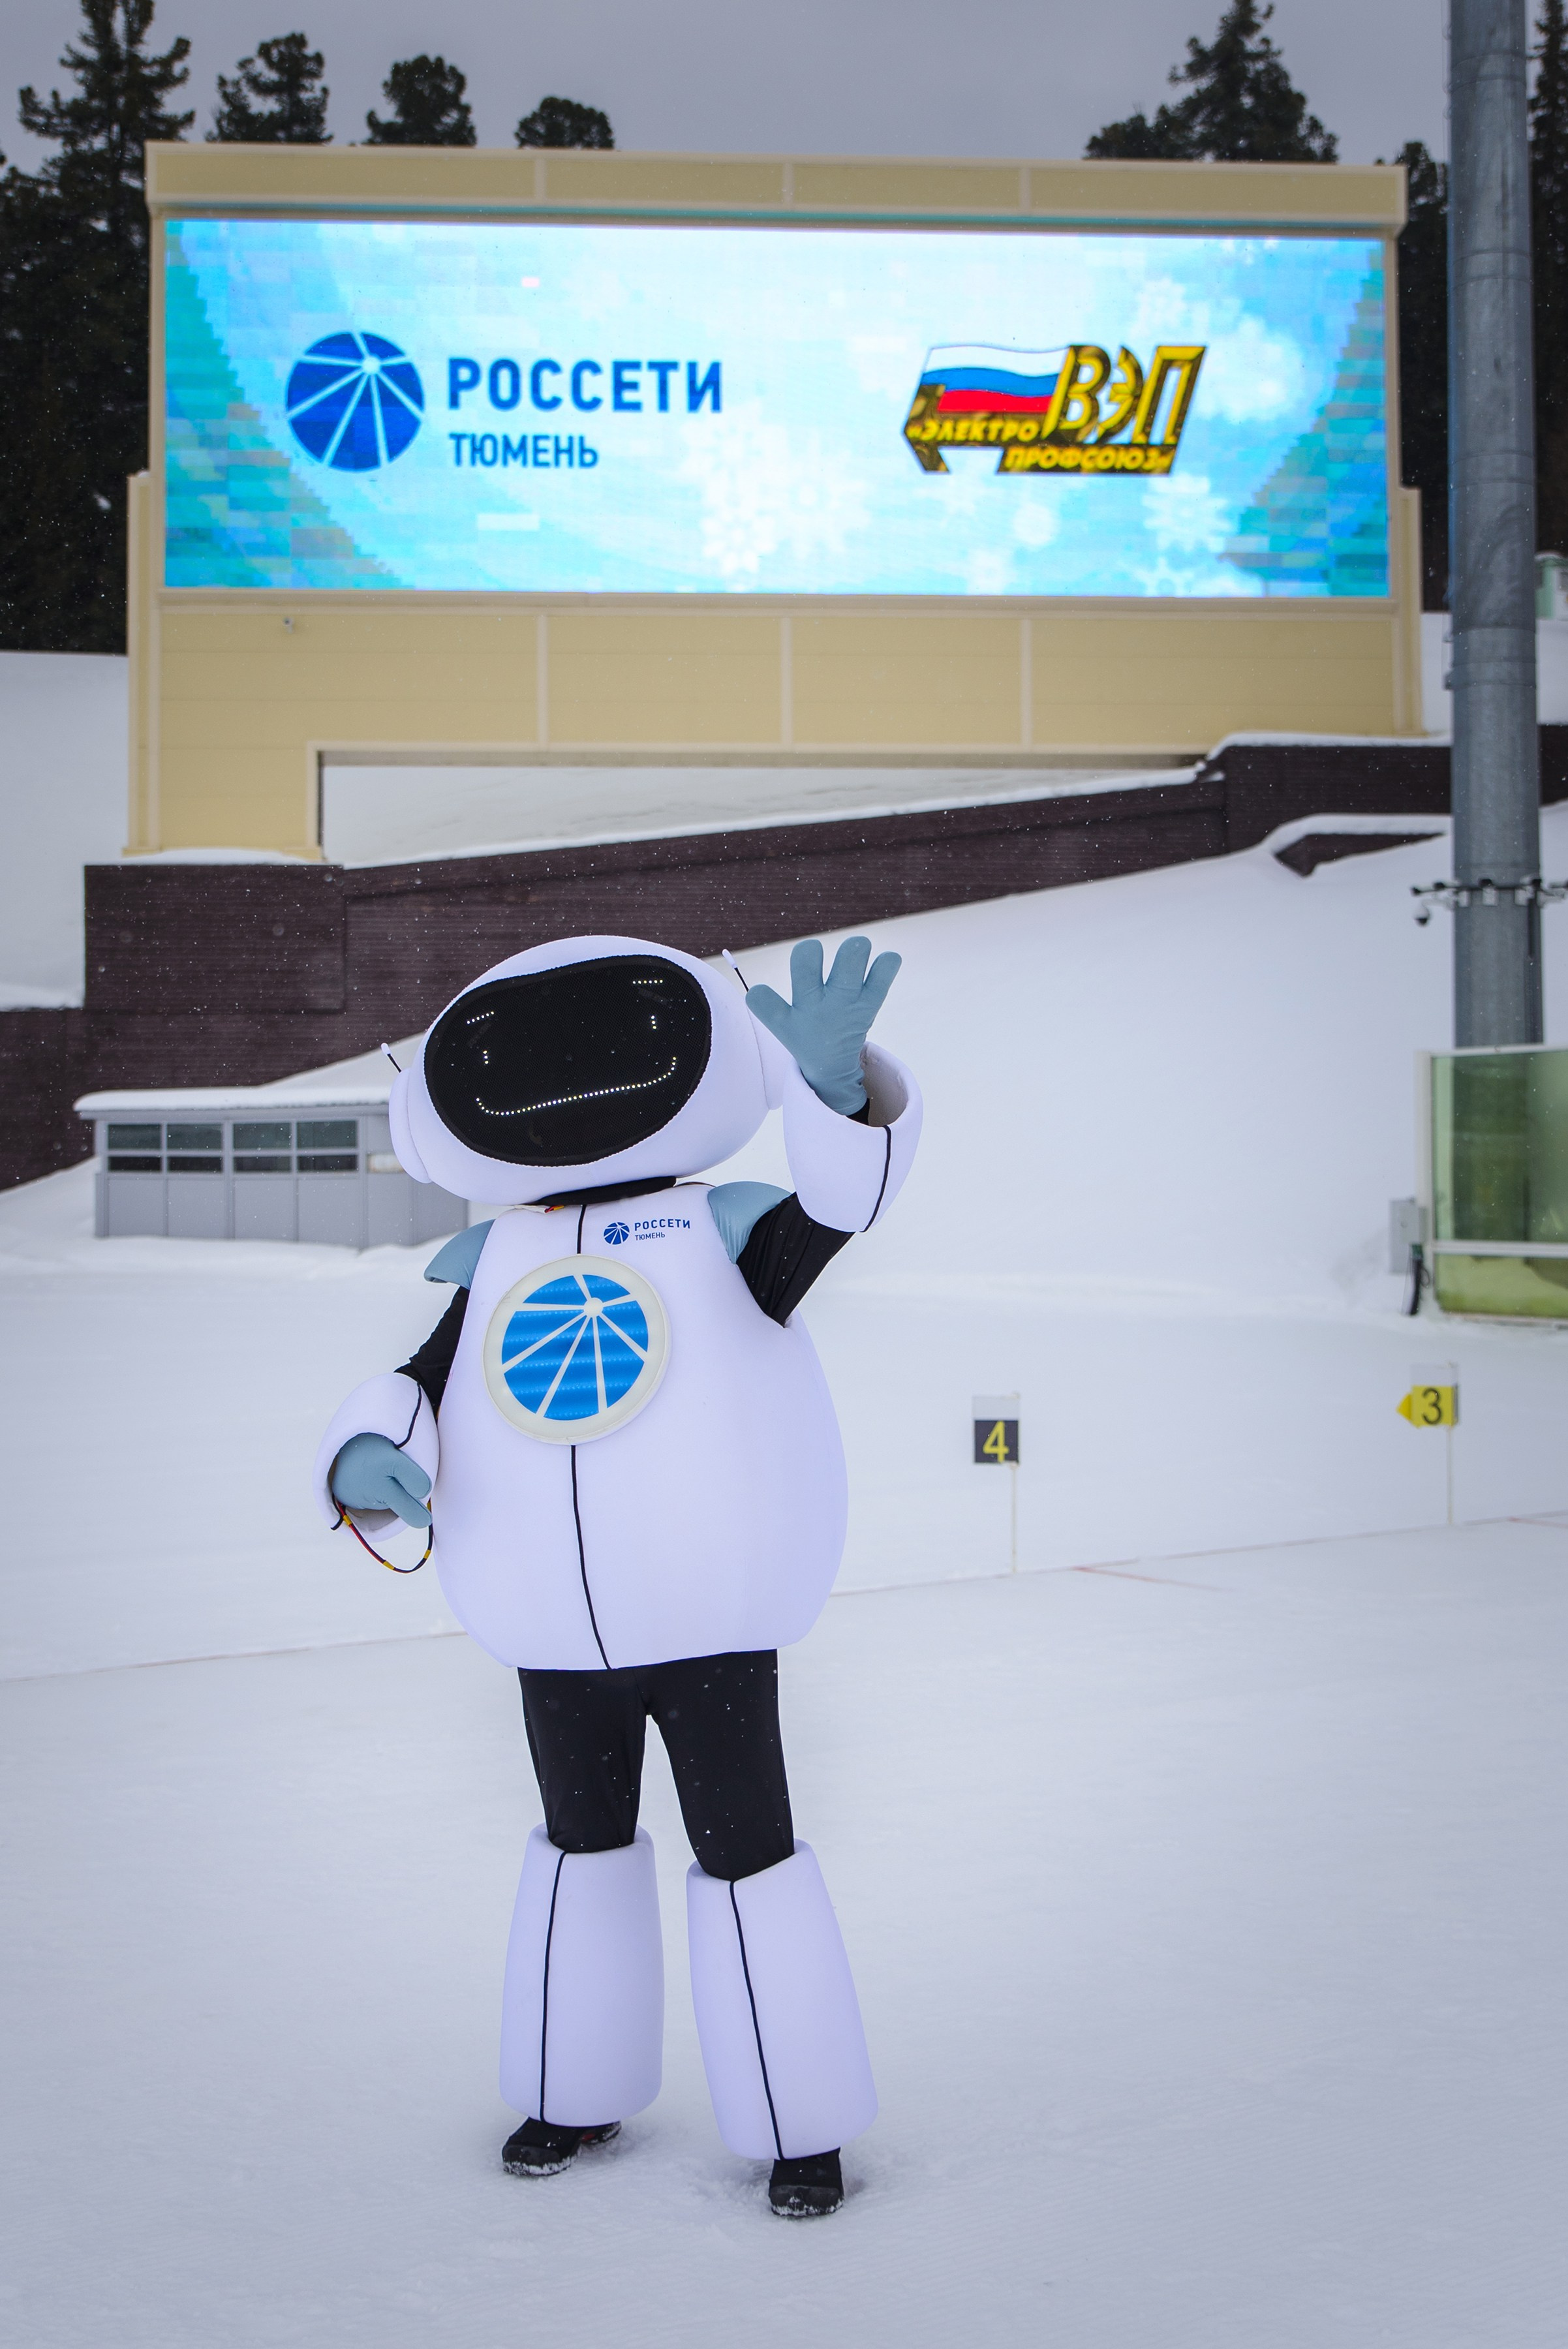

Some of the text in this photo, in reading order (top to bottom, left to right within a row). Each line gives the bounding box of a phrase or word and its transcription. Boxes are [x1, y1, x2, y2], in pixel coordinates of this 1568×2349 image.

[448, 357, 722, 413] РОССЕТИ
[1041, 345, 1207, 446] ВЭП
[449, 433, 599, 468] ТЮМЕНЬ
[634, 1219, 690, 1231] РОССЕТИ
[635, 1232, 666, 1241] ТЮМЕНЬ
[1422, 1387, 1442, 1426] 3
[982, 1420, 1009, 1463] 4
